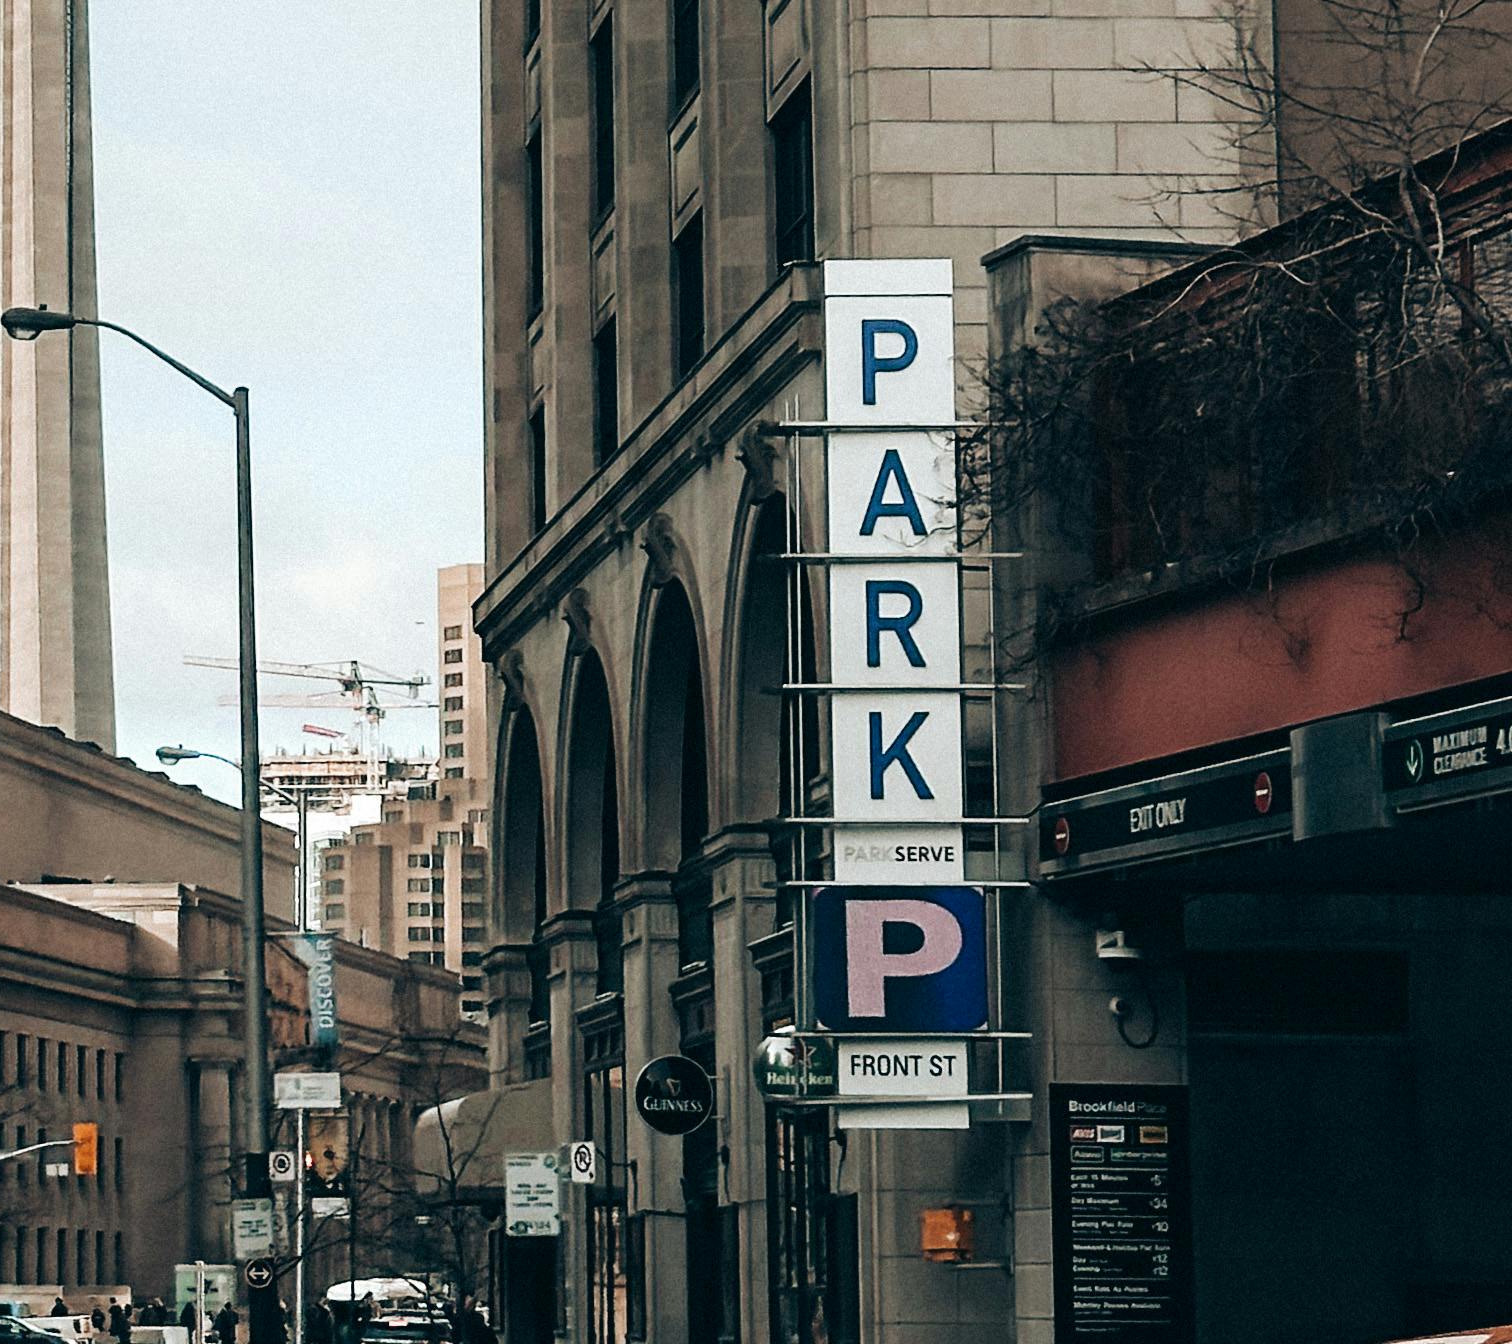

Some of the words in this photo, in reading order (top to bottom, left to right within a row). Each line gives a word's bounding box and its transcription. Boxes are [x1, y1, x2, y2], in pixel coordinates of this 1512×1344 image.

[860, 318, 935, 800] PARK
[1432, 725, 1487, 755] MAXIMUM
[1129, 803, 1155, 833] EXIT
[1155, 797, 1187, 828] ONLY
[845, 899, 963, 1018] P
[316, 939, 334, 1028] DISCOVER
[850, 1054, 923, 1077] FRONT
[929, 1054, 957, 1077] ST
[643, 1096, 703, 1112] GUINNESS
[1068, 1099, 1136, 1113] Brookfield
